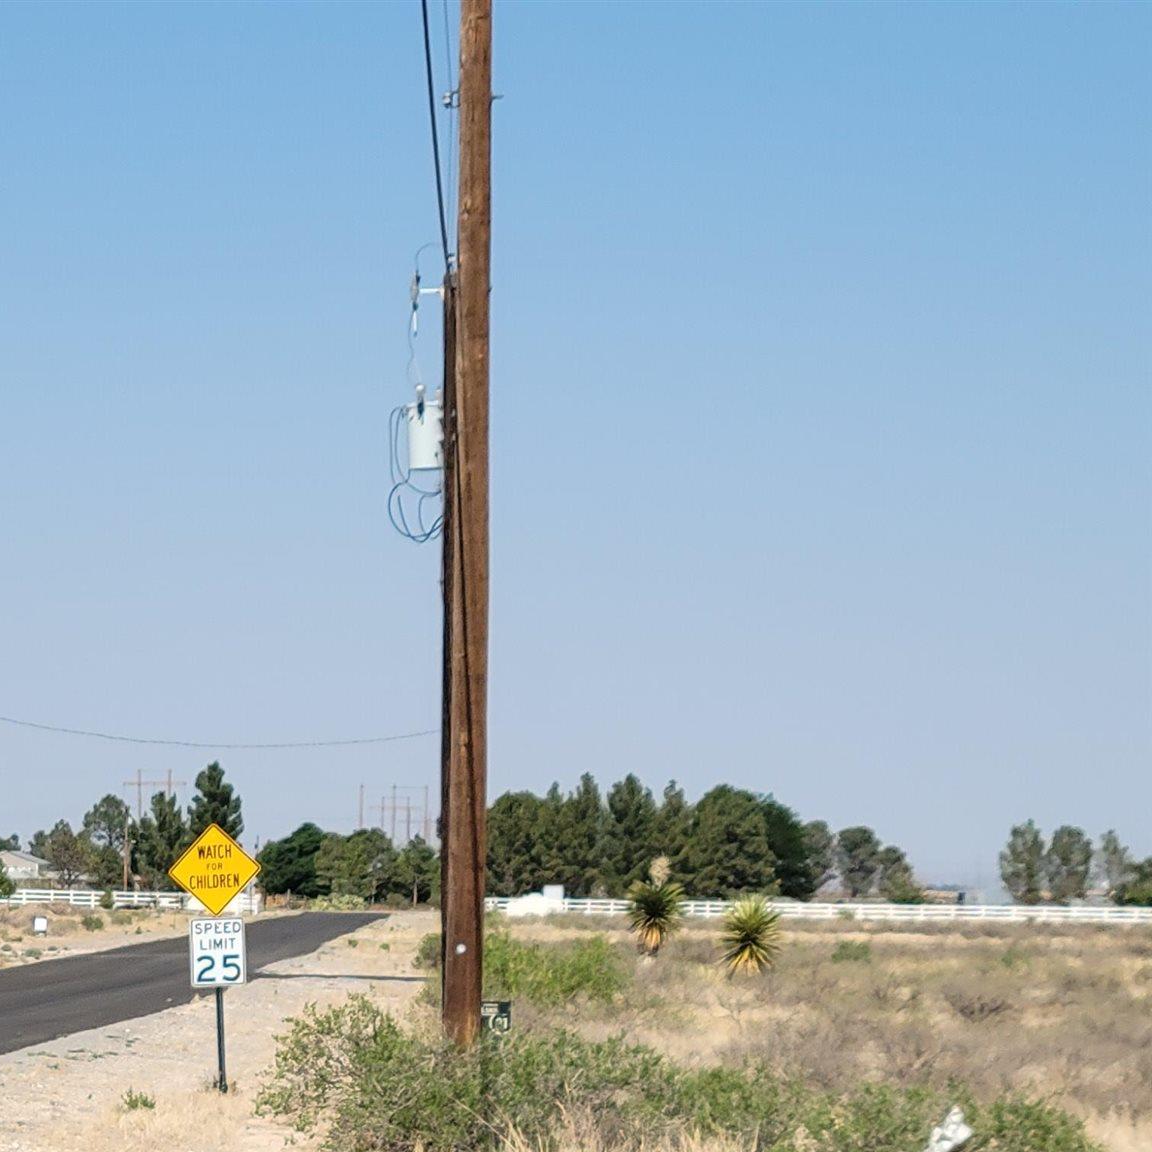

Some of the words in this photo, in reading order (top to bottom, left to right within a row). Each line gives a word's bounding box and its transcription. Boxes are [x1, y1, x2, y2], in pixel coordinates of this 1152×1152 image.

[198, 844, 232, 860] WATCH
[206, 862, 223, 871] FOR
[189, 873, 240, 890] CHILDREN
[195, 921, 241, 935] SPEED
[200, 938, 236, 951] LIMIT
[197, 954, 241, 982] 25
